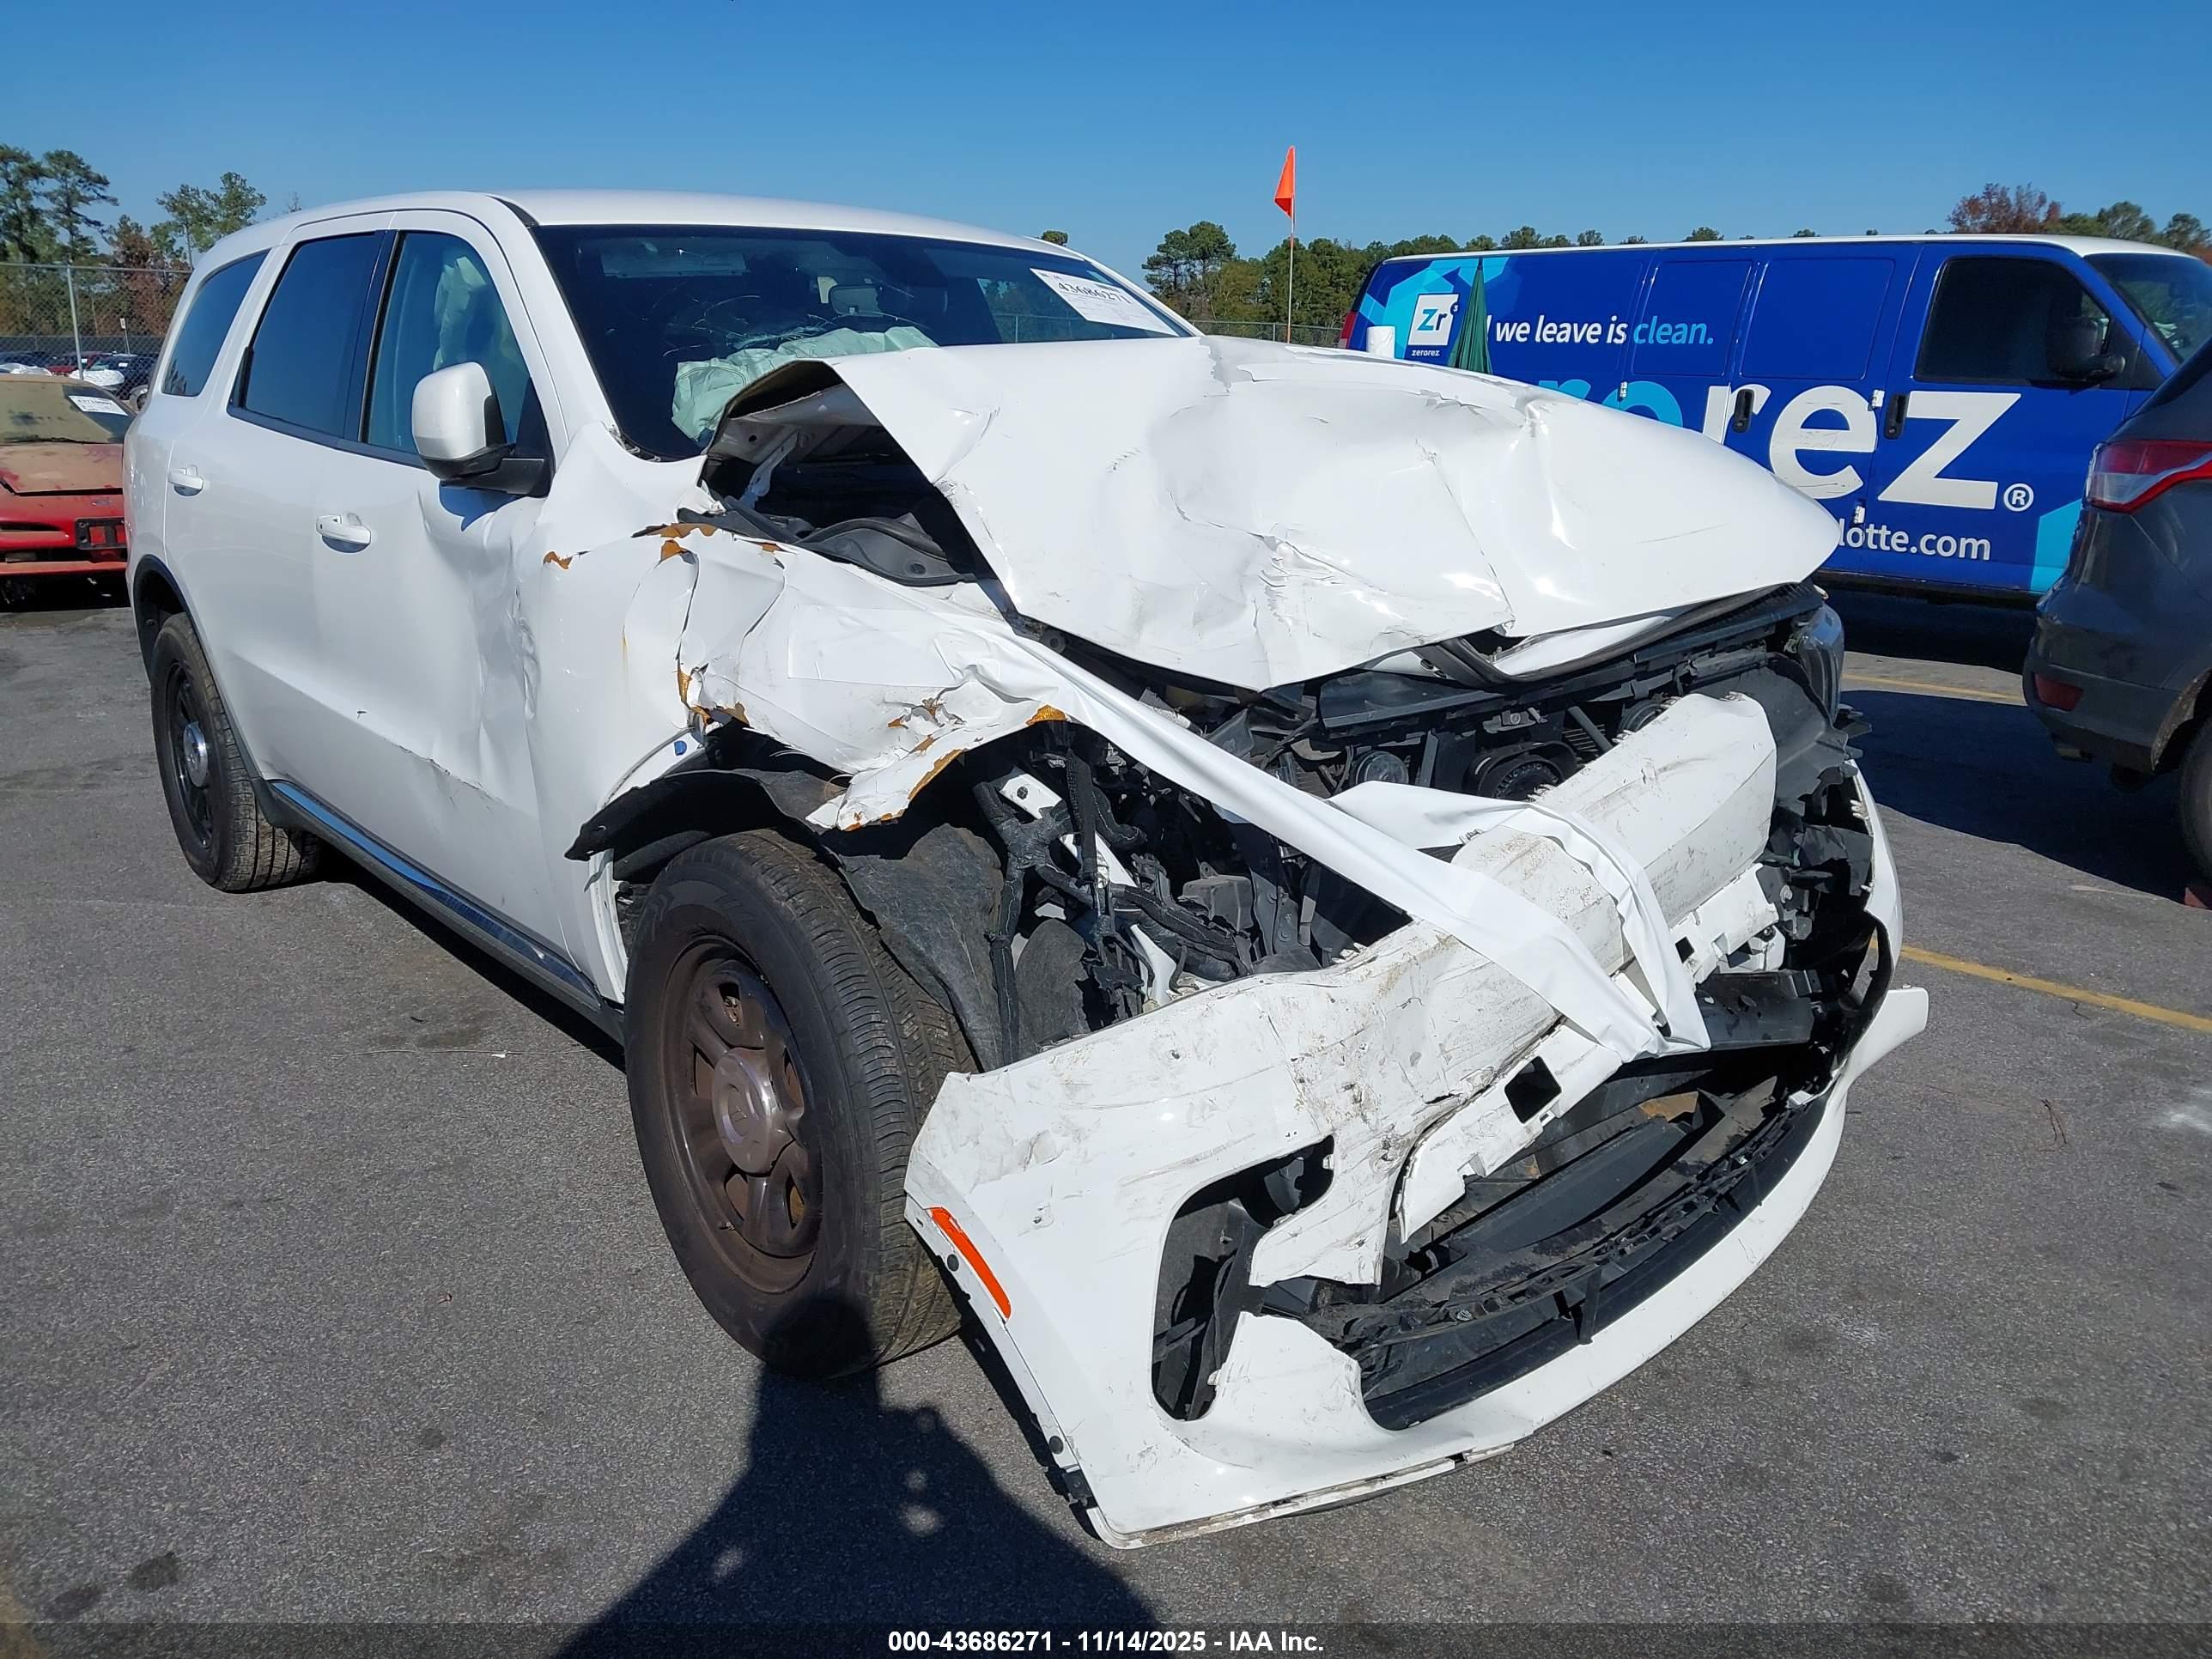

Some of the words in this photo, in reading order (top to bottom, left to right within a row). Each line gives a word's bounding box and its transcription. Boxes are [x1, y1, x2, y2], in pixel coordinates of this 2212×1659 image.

[1496, 321, 1530, 342] we
[1535, 314, 1602, 343] leave
[1607, 315, 1628, 343] is
[1633, 315, 1714, 344] clean.
